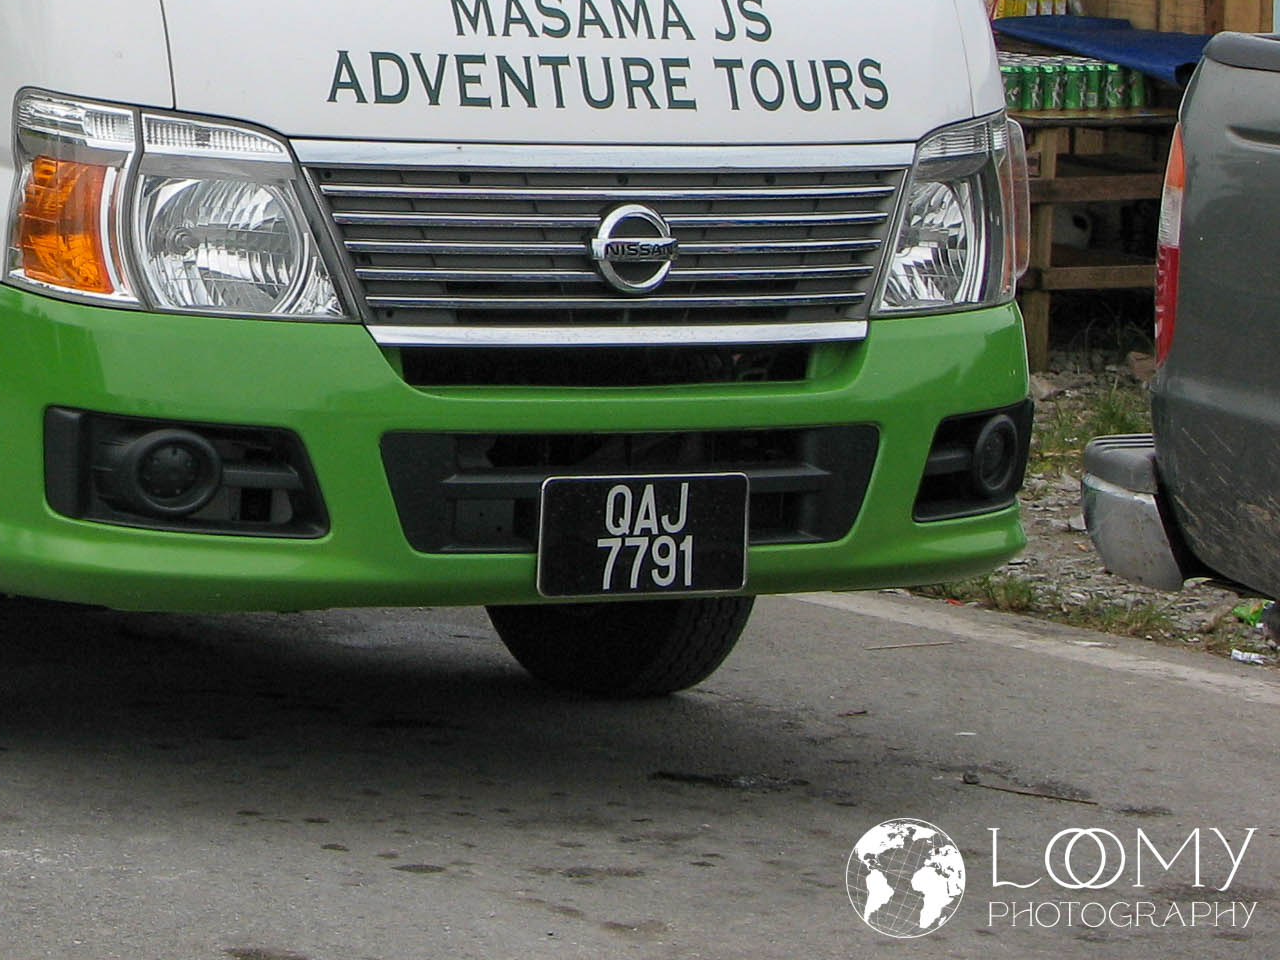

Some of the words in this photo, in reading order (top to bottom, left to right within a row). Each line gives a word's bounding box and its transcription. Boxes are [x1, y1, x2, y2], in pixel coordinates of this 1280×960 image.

[327, 50, 698, 112] ADVENTURE
[713, 57, 889, 112] TOURS
[605, 243, 673, 256] NISSAN
[605, 482, 689, 536] QAJ
[597, 534, 693, 590] 7791
